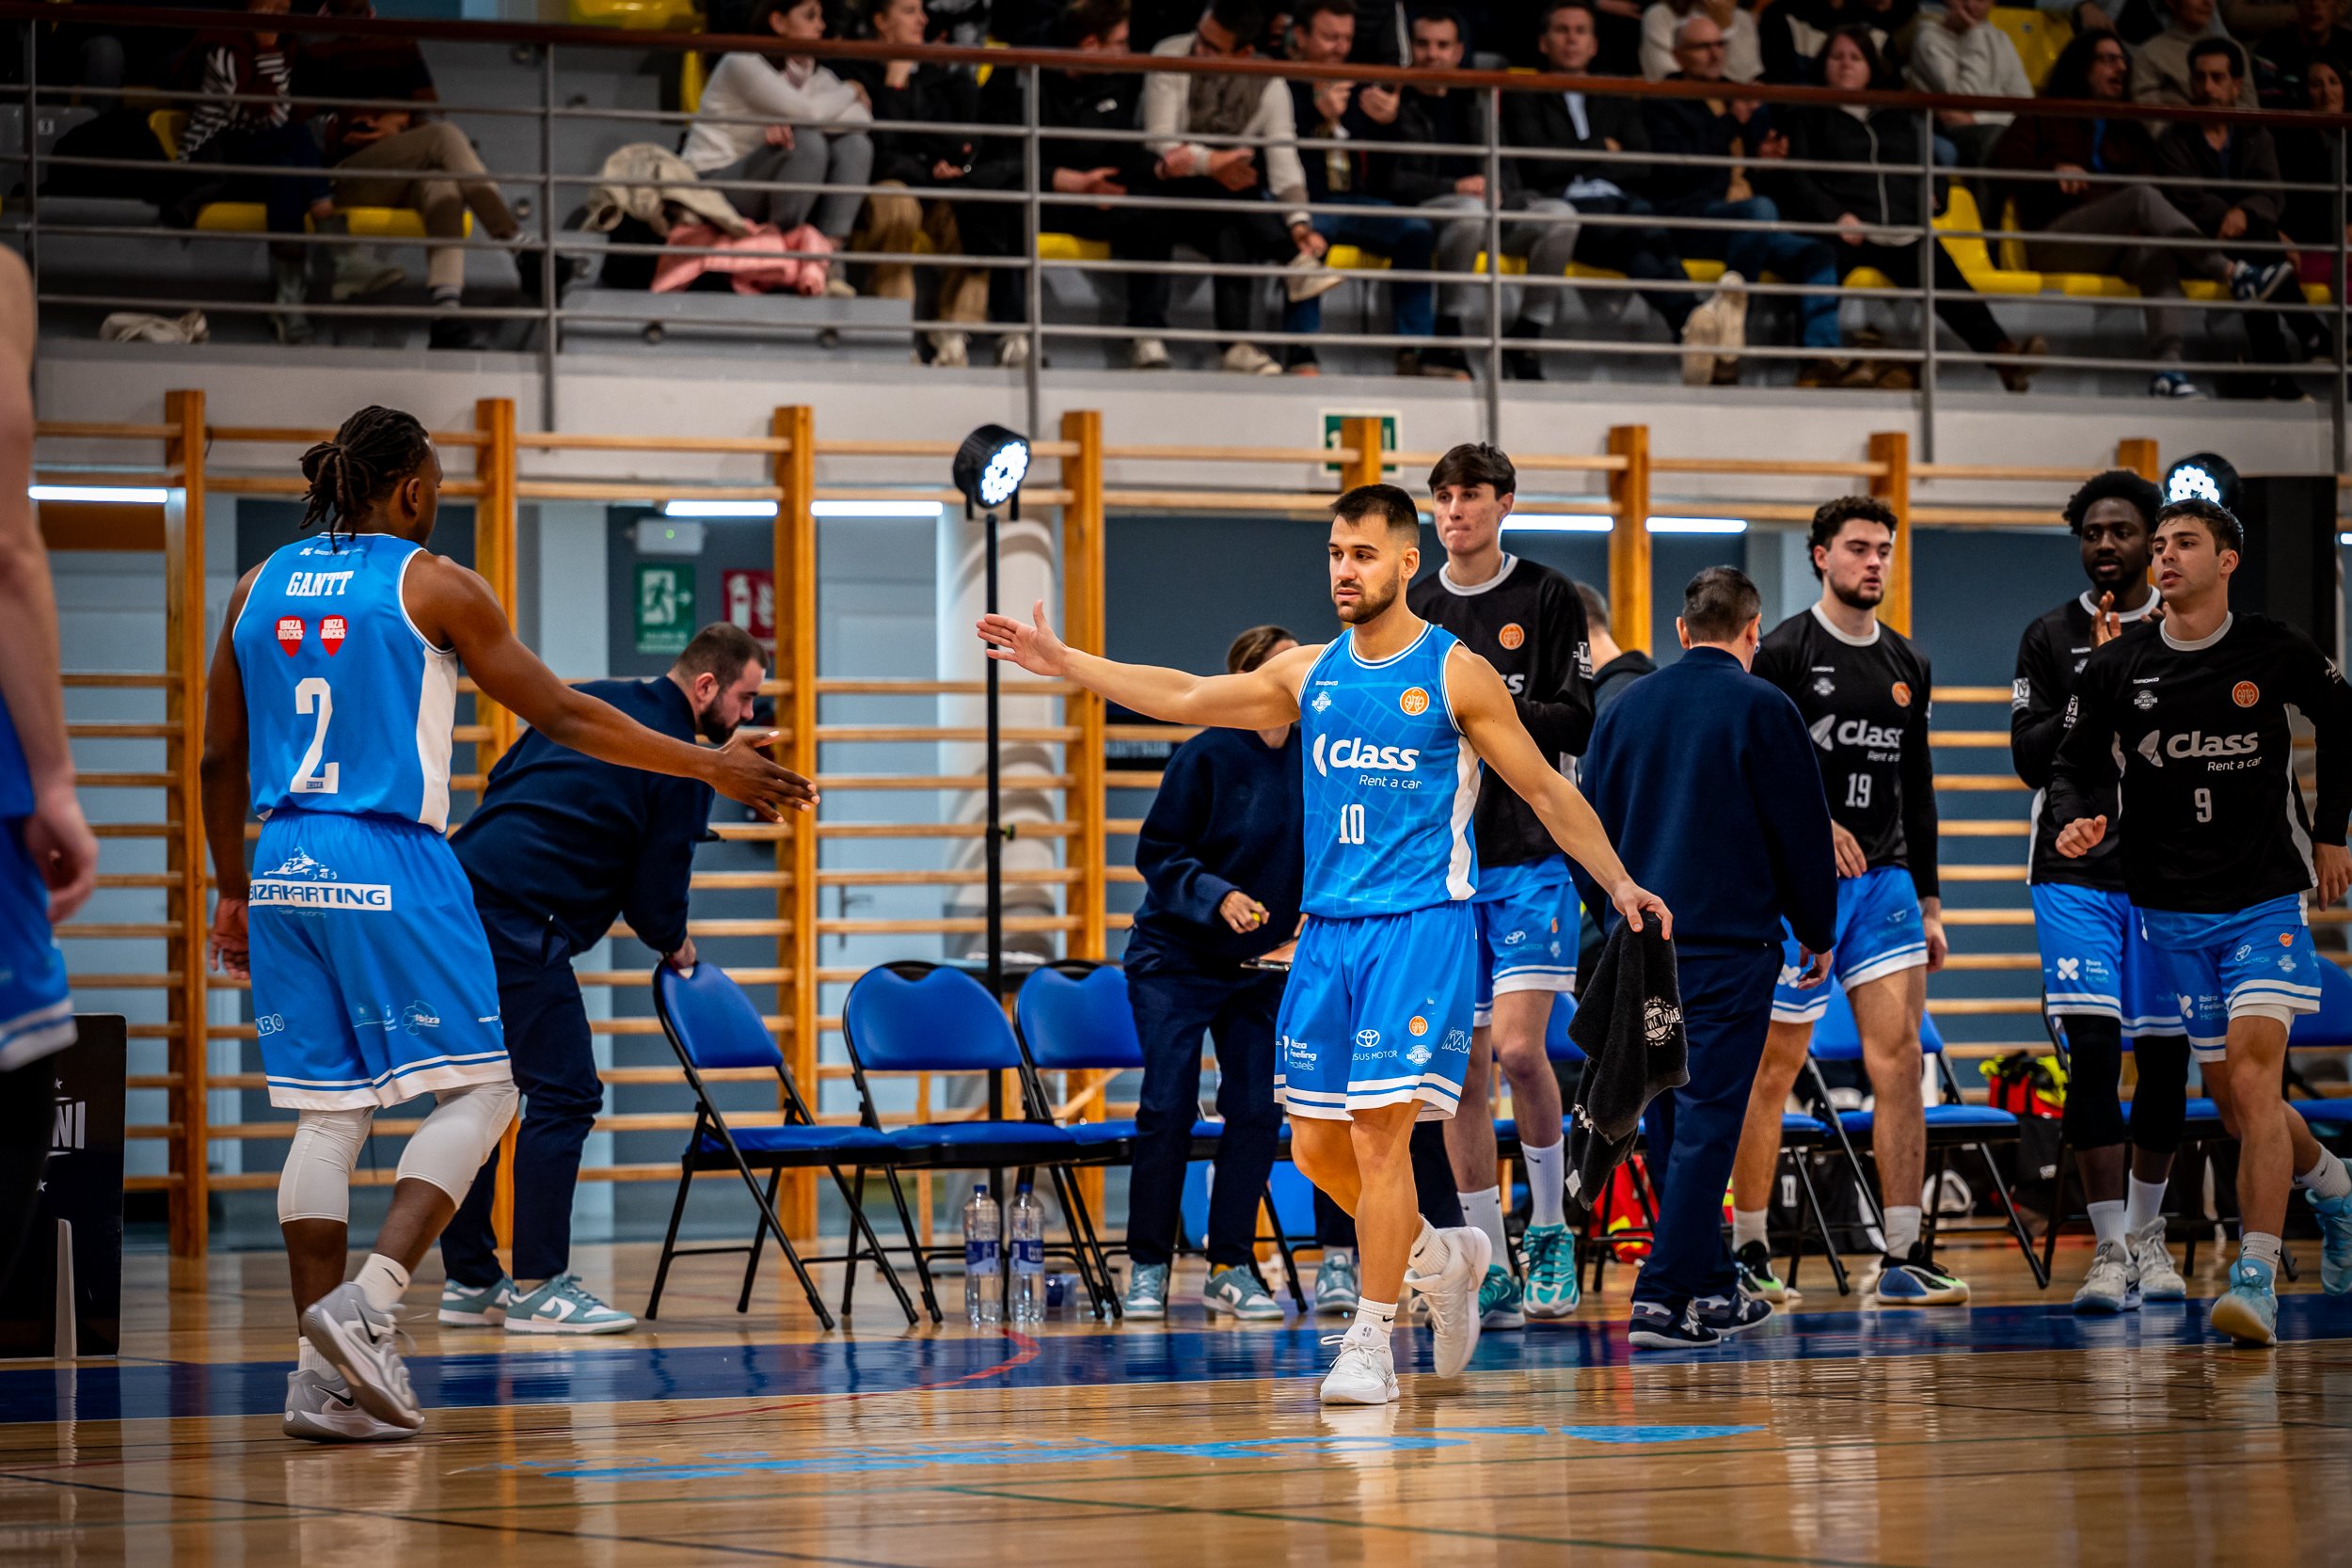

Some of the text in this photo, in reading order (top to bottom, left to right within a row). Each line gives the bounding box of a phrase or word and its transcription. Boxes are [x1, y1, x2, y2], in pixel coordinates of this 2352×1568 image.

[286, 571, 355, 596] GANTT
[290, 677, 339, 794] 2
[2167, 731, 2258, 758] Class
[1329, 737, 1420, 771] Class
[2208, 761, 2234, 771] Rent
[2247, 756, 2263, 767] car
[1359, 774, 1422, 789] Rent a car
[1845, 773, 1872, 808] 19
[2194, 787, 2212, 823] 9
[1339, 804, 1365, 845] 10
[1371, 1050, 1397, 1060] MOTOR
